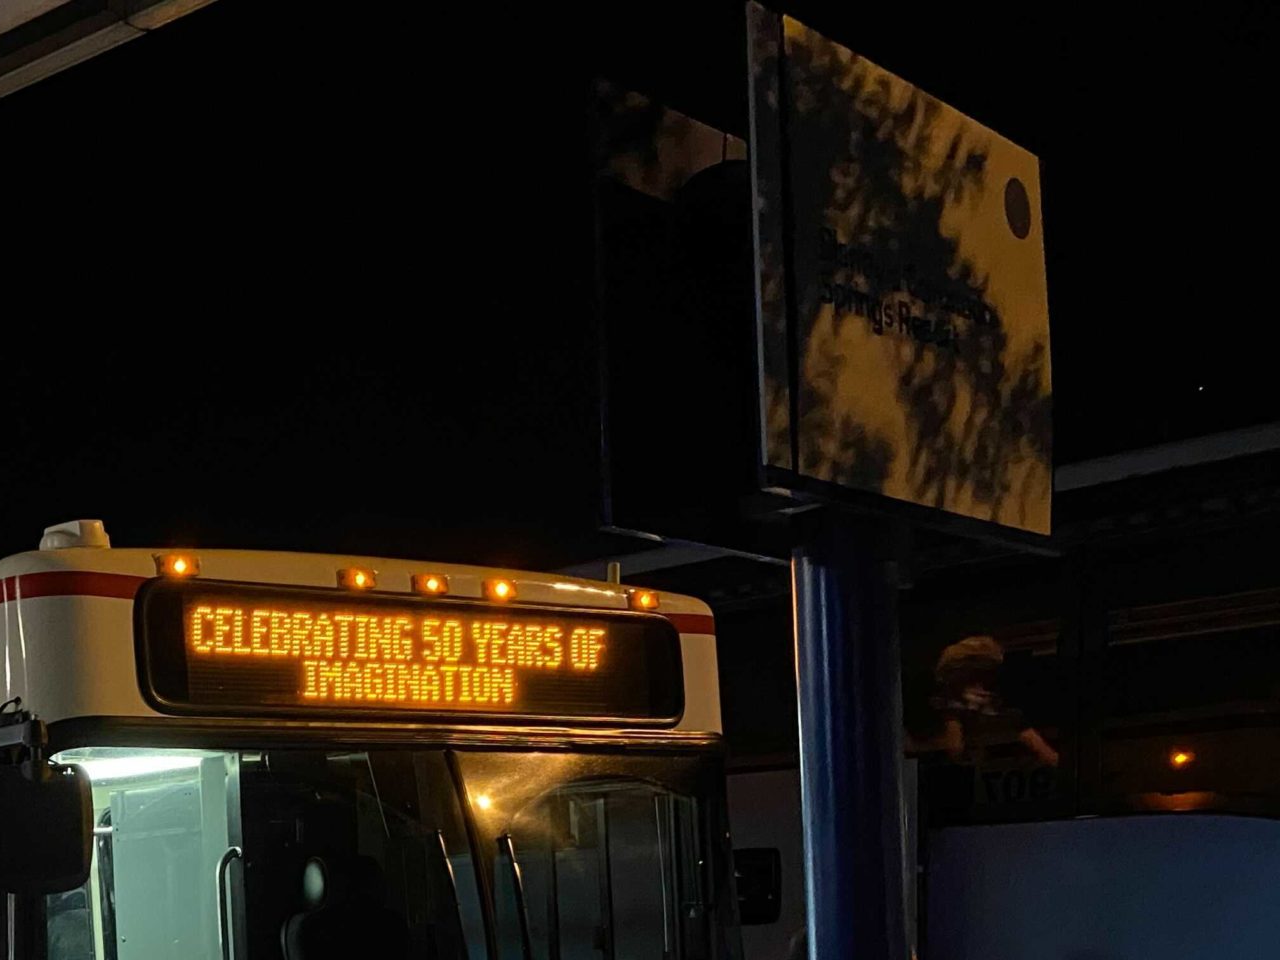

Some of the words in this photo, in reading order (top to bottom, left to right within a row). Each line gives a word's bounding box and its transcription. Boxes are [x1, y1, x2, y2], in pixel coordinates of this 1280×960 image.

[192, 606, 413, 660] CELEBRATING
[422, 618, 463, 662] 50
[471, 620, 564, 668] YEARS
[569, 628, 607, 670] OF
[303, 660, 515, 704] IMAGINATION
